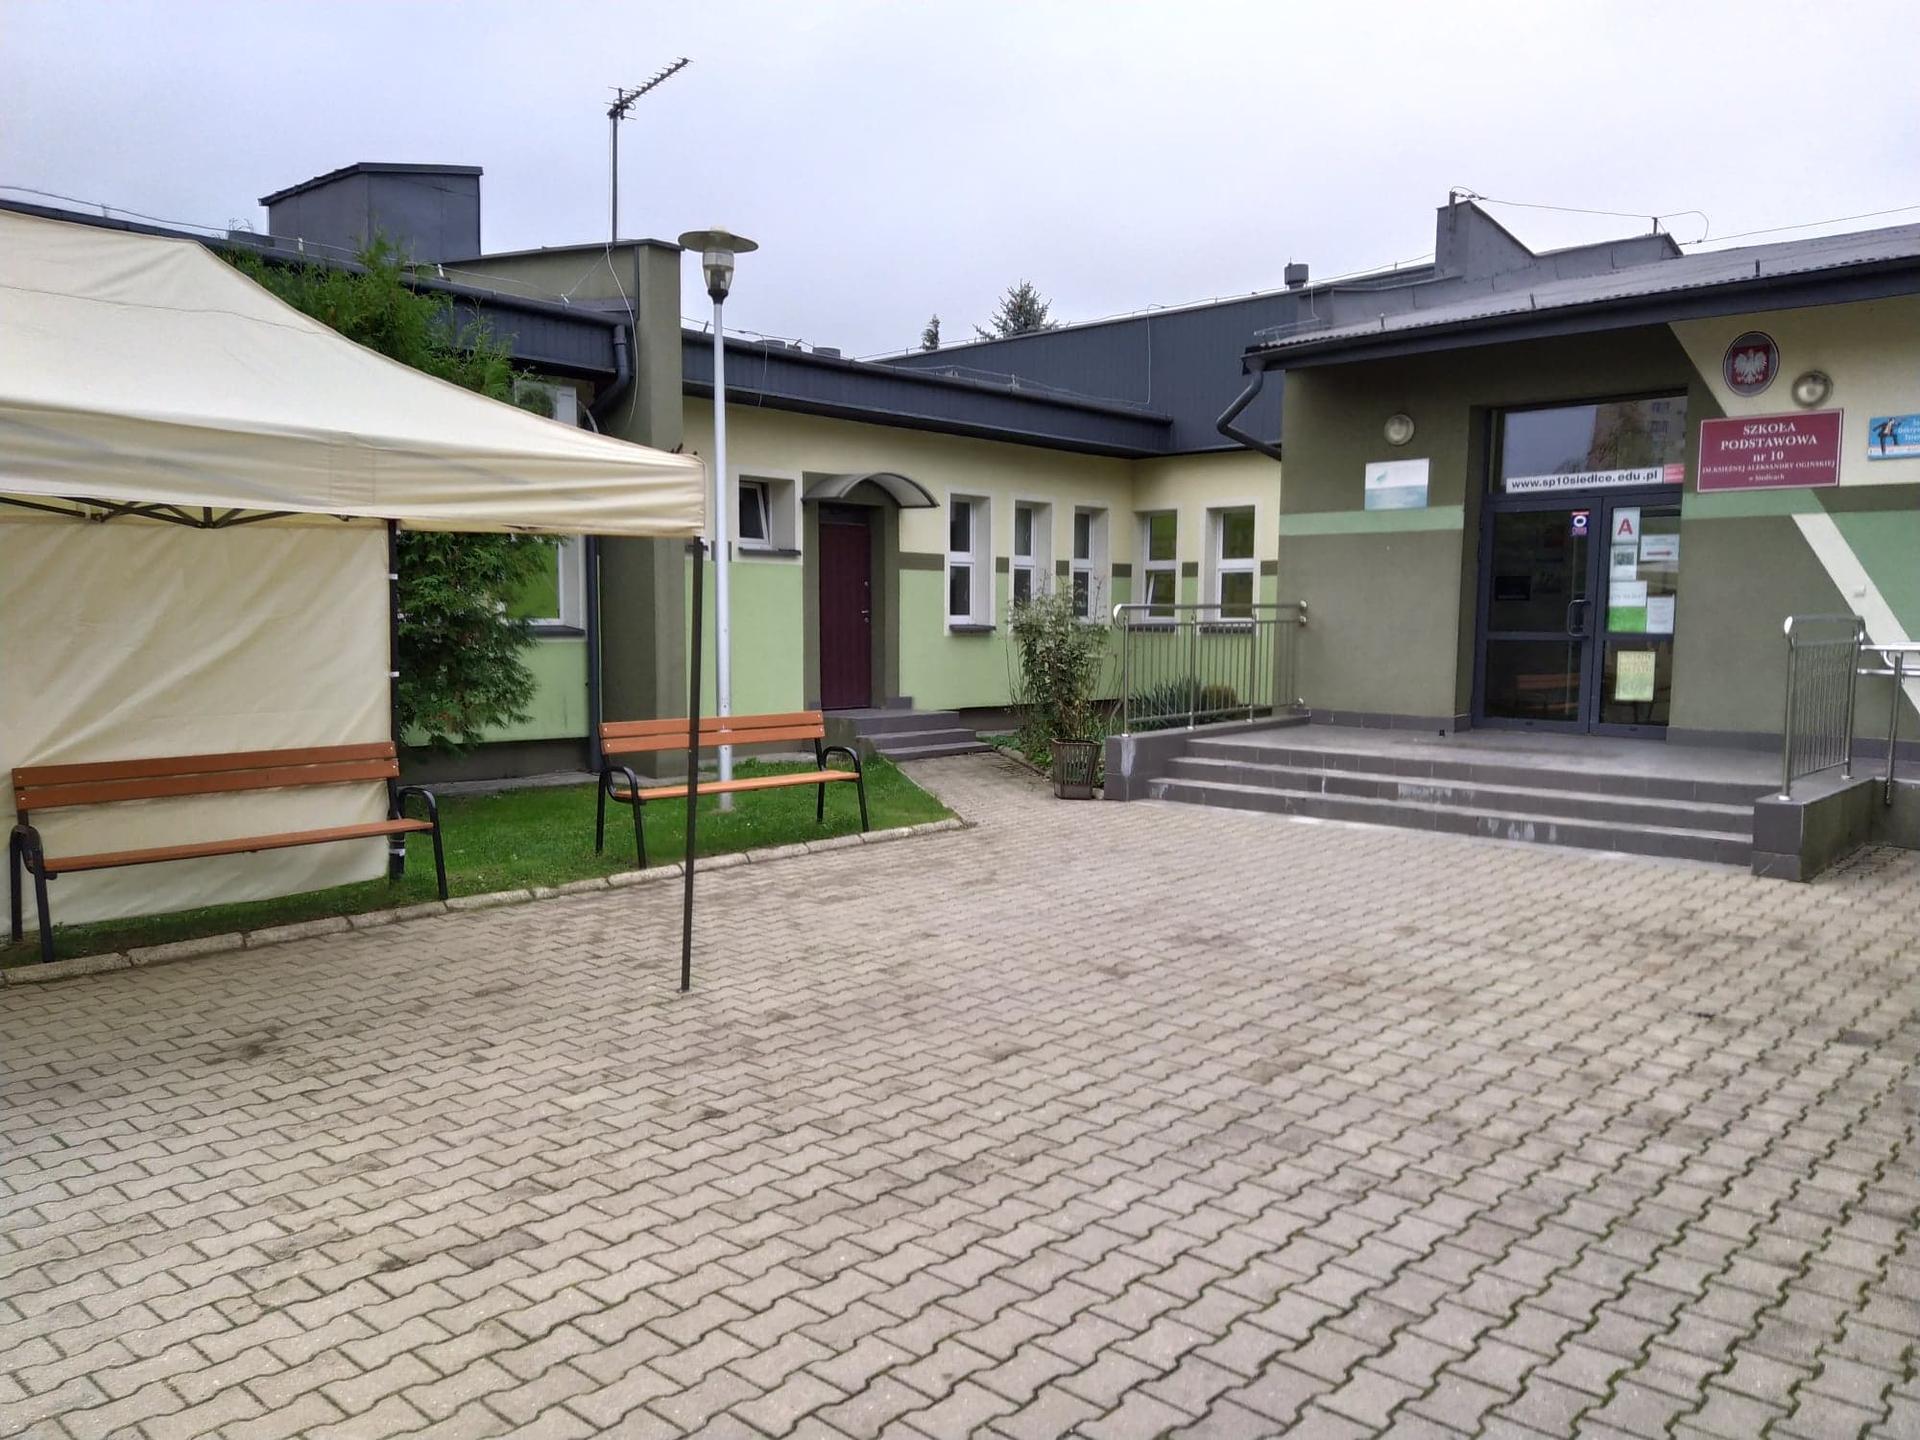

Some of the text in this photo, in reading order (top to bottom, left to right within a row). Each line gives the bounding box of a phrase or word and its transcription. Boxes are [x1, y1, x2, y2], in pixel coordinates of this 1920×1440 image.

[1743, 422, 1796, 435] SZKOŁA
[1721, 434, 1817, 450] PODSTAWOWA
[1753, 451, 1784, 462] nr 10
[1617, 518, 1633, 535] A
